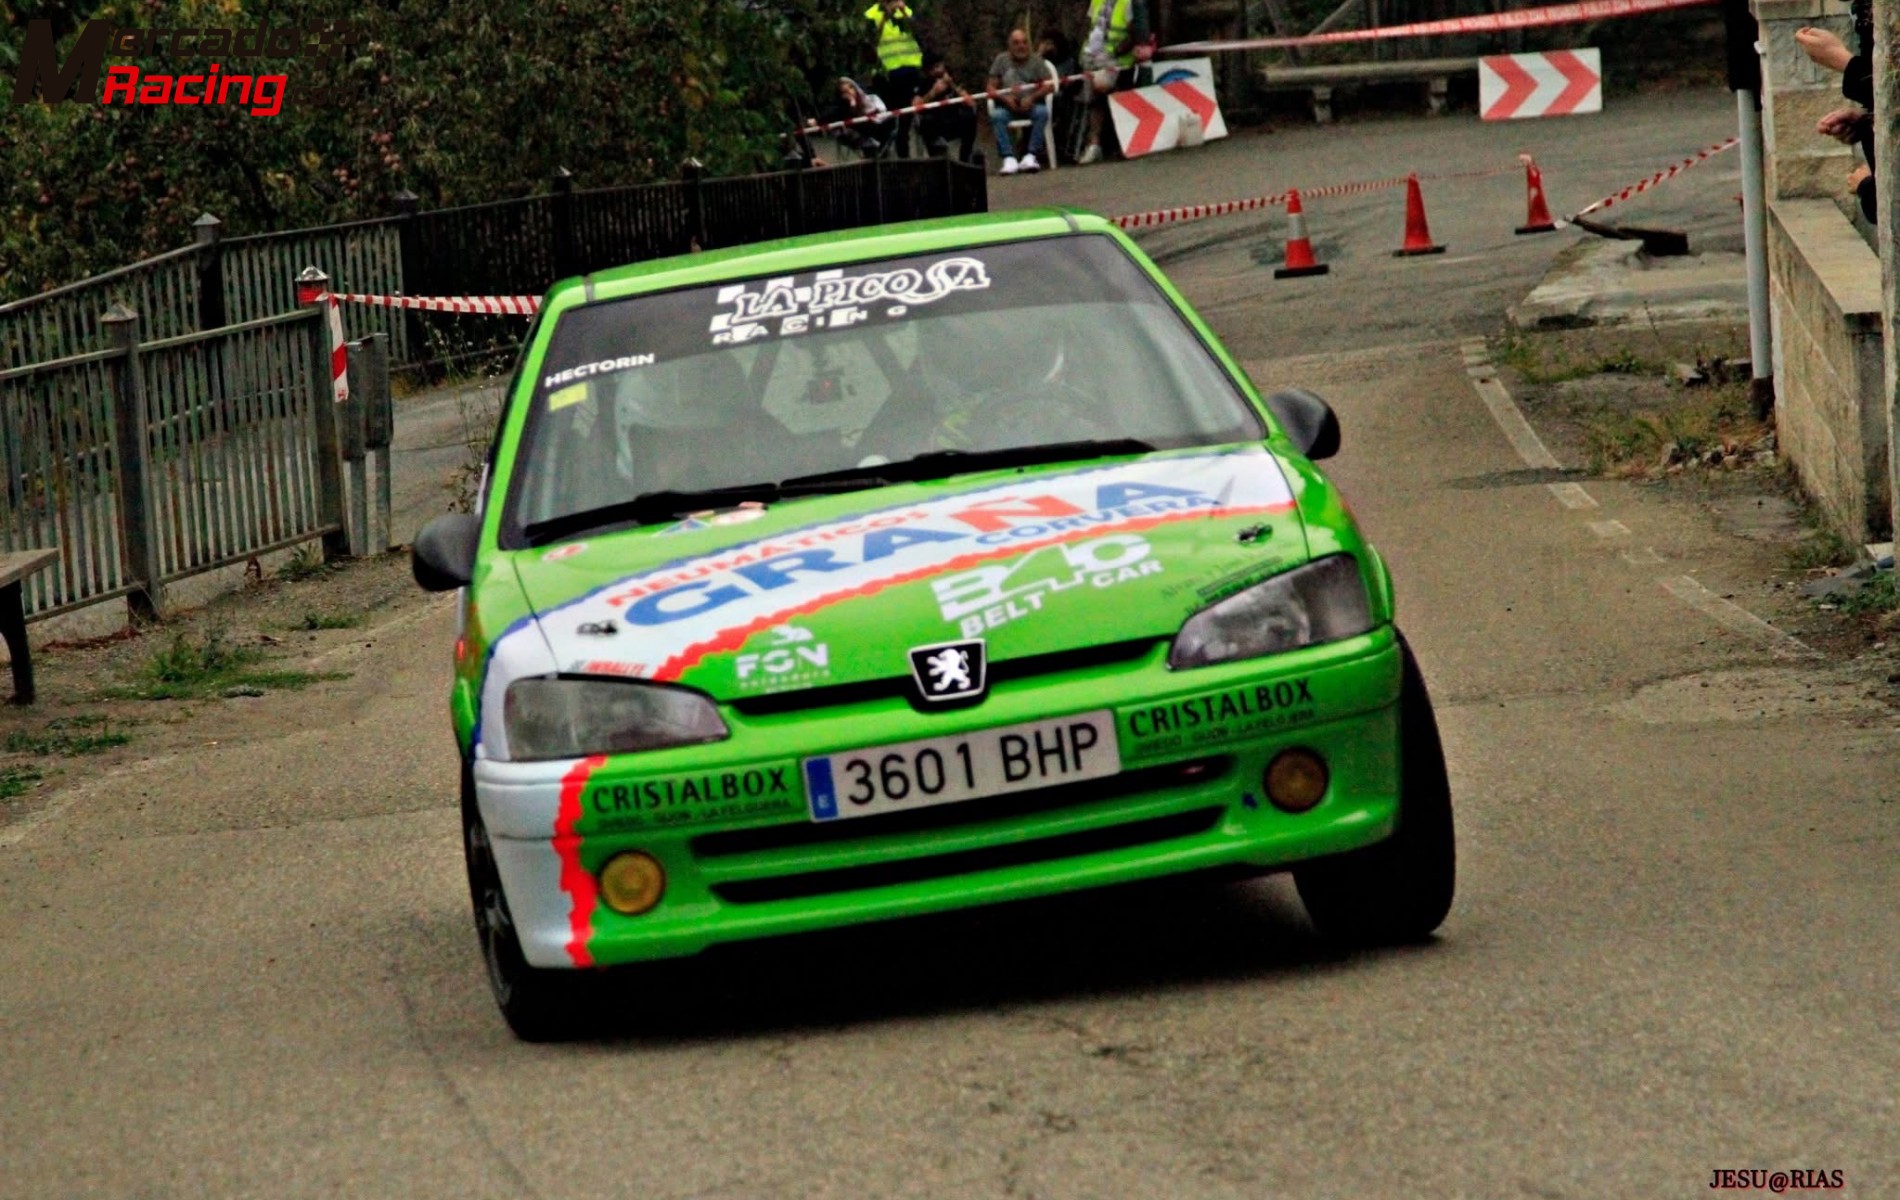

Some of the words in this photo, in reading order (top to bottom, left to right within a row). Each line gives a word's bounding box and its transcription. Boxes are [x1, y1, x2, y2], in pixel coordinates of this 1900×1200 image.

[730, 286, 798, 323] LA
[809, 257, 990, 308] PICOSA
[544, 353, 655, 388] HECTORIN
[976, 496, 1222, 545] CORVERA
[606, 508, 930, 608] NEUMATICOS
[960, 590, 1046, 639] BELT
[1091, 559, 1163, 587] CAR
[1129, 677, 1313, 738] CRISTALBOX
[592, 767, 788, 813] CRISTALBOX
[845, 742, 975, 806] 3601
[1000, 722, 1099, 783] BHP
